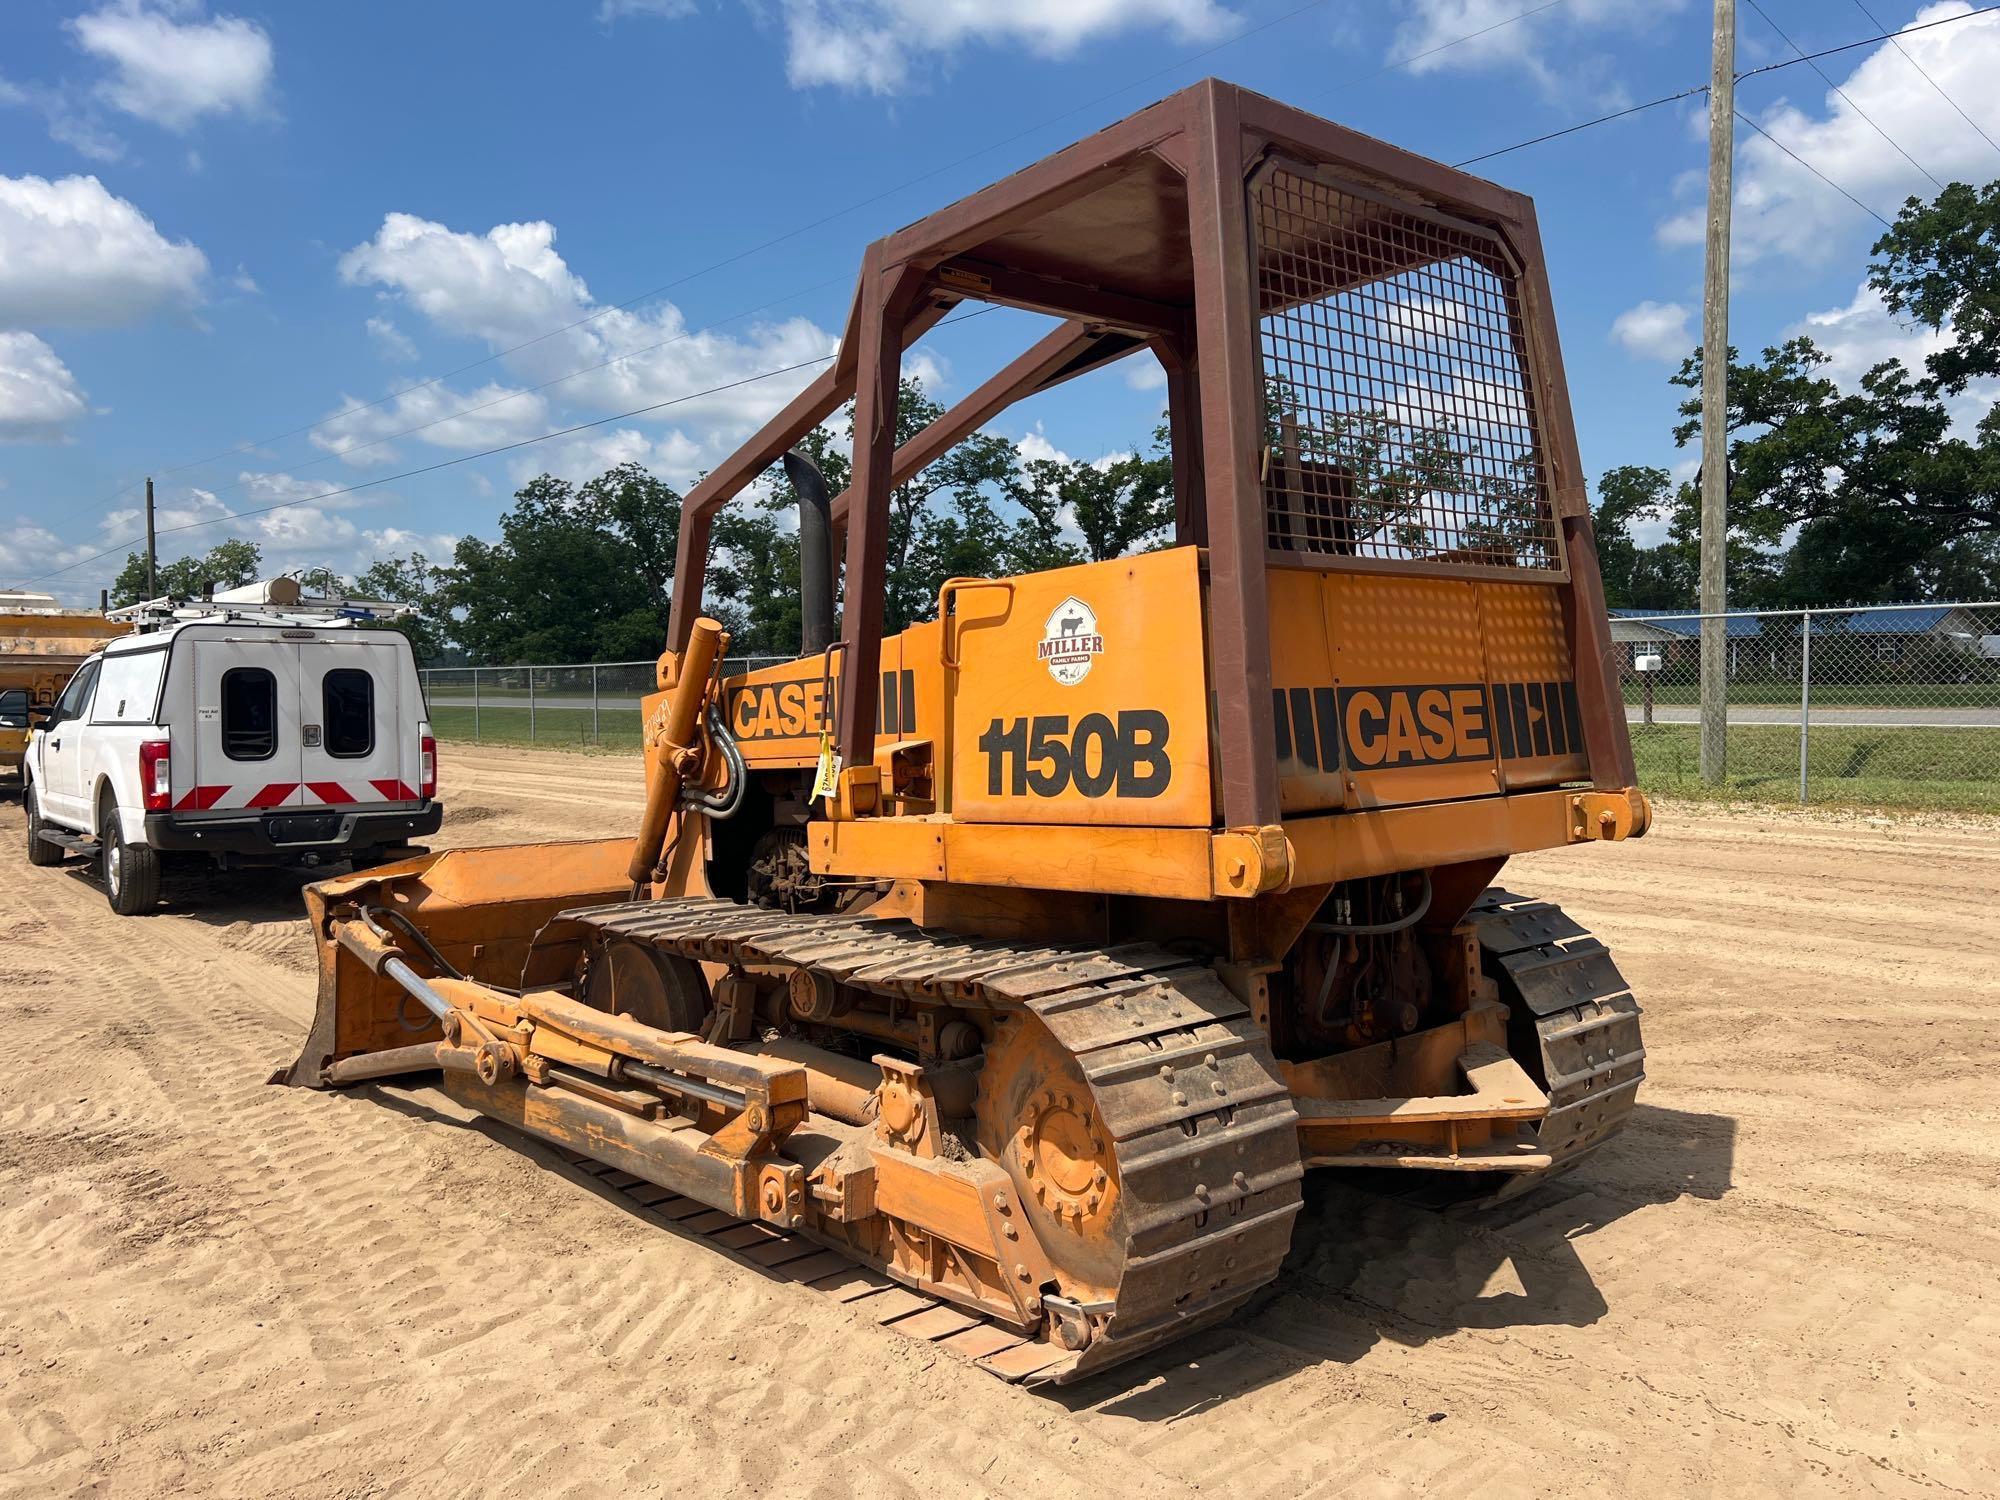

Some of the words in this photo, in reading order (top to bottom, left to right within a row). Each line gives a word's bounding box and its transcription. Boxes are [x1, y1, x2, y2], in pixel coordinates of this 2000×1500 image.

[1038, 636, 1103, 659] MILLER
[1052, 657, 1071, 665] FAMILY
[1071, 655, 1088, 663] FARMS
[734, 684, 832, 738] CASE
[1345, 688, 1490, 766] CASE
[978, 709, 1172, 798] 1150B
